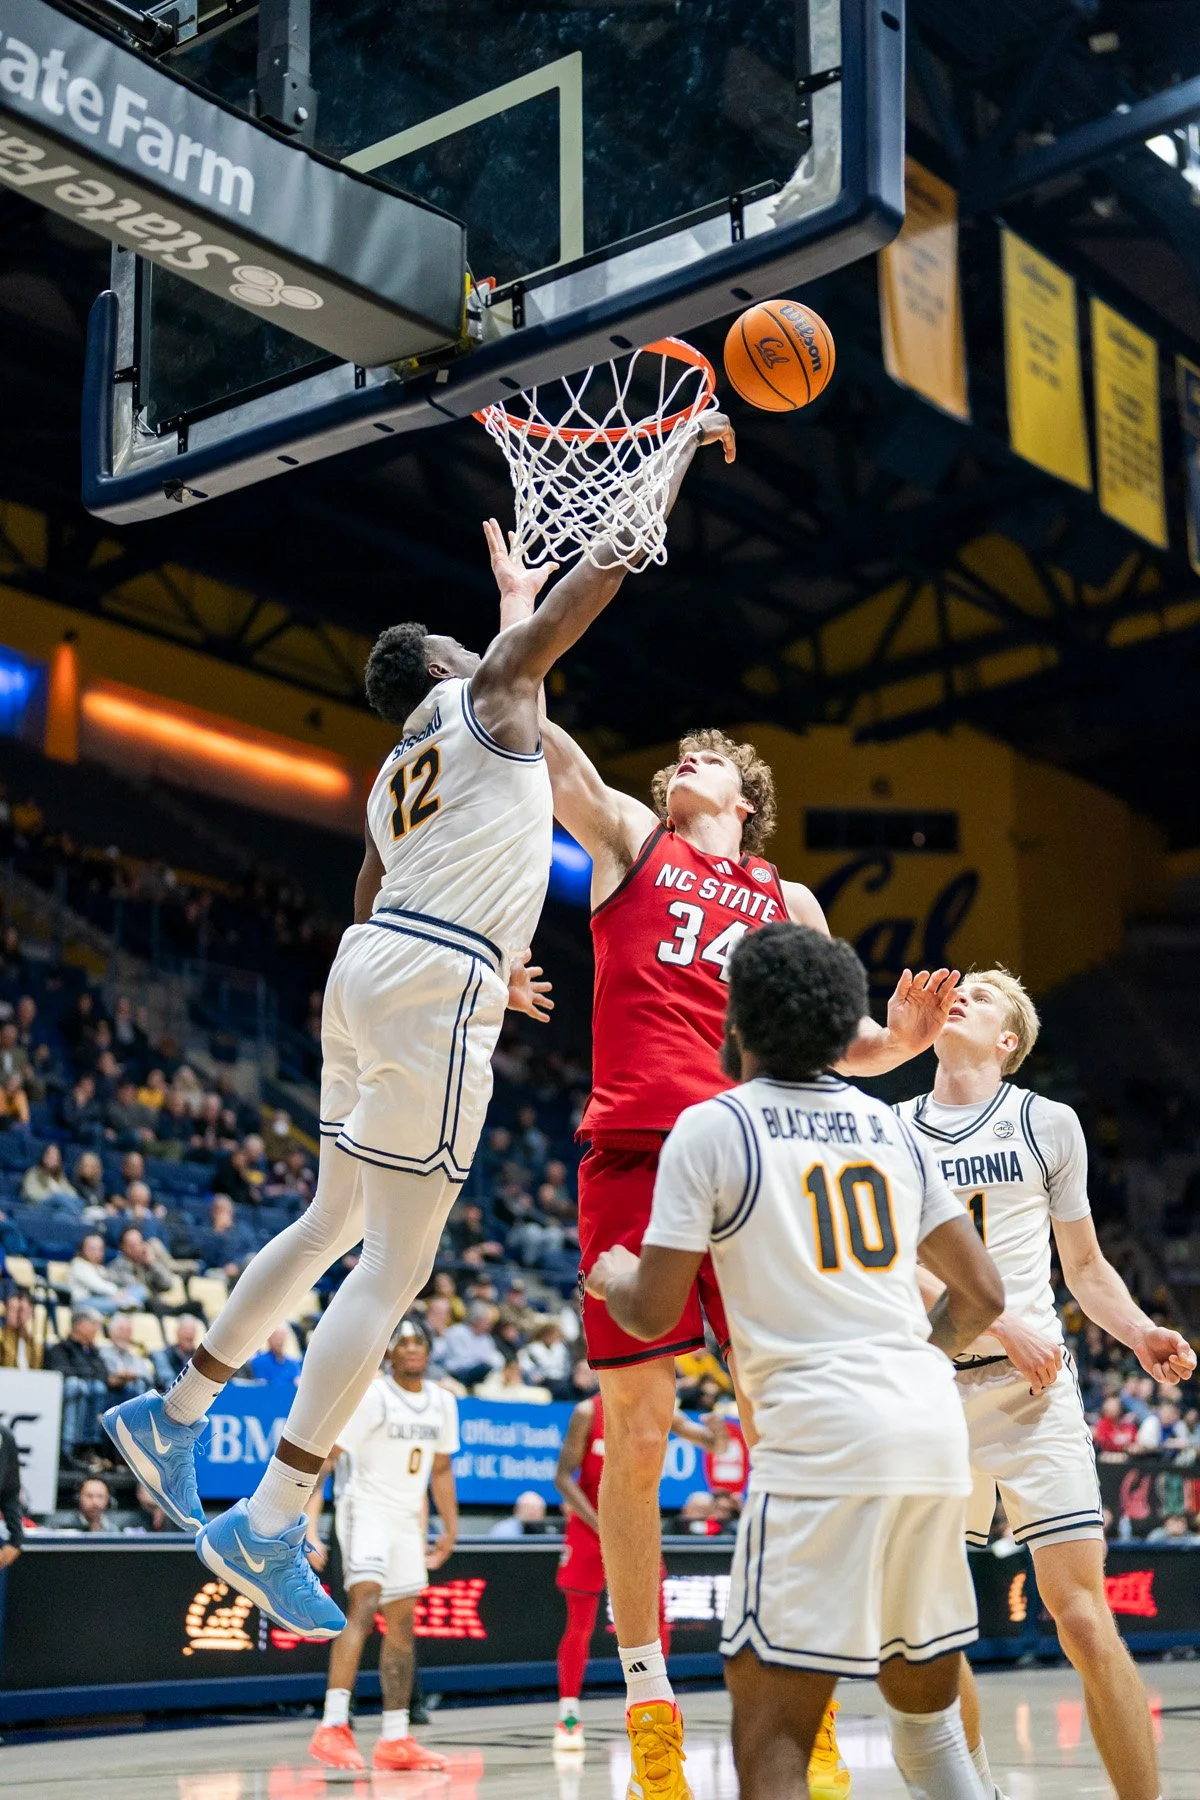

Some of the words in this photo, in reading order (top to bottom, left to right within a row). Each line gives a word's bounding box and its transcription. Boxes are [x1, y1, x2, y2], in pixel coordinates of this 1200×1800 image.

[754, 337, 790, 369] Cal
[780, 305, 822, 373] Wilson
[389, 744, 441, 841] 12
[654, 863, 698, 892] NC
[697, 877, 779, 924] STATE
[656, 899, 752, 983] 34
[761, 1107, 862, 1144] BLACKSHER
[938, 1150, 1024, 1187] FORNIA
[802, 1161, 898, 1272] 10
[207, 1414, 288, 1465] BM
[408, 1446, 423, 1475] 0
